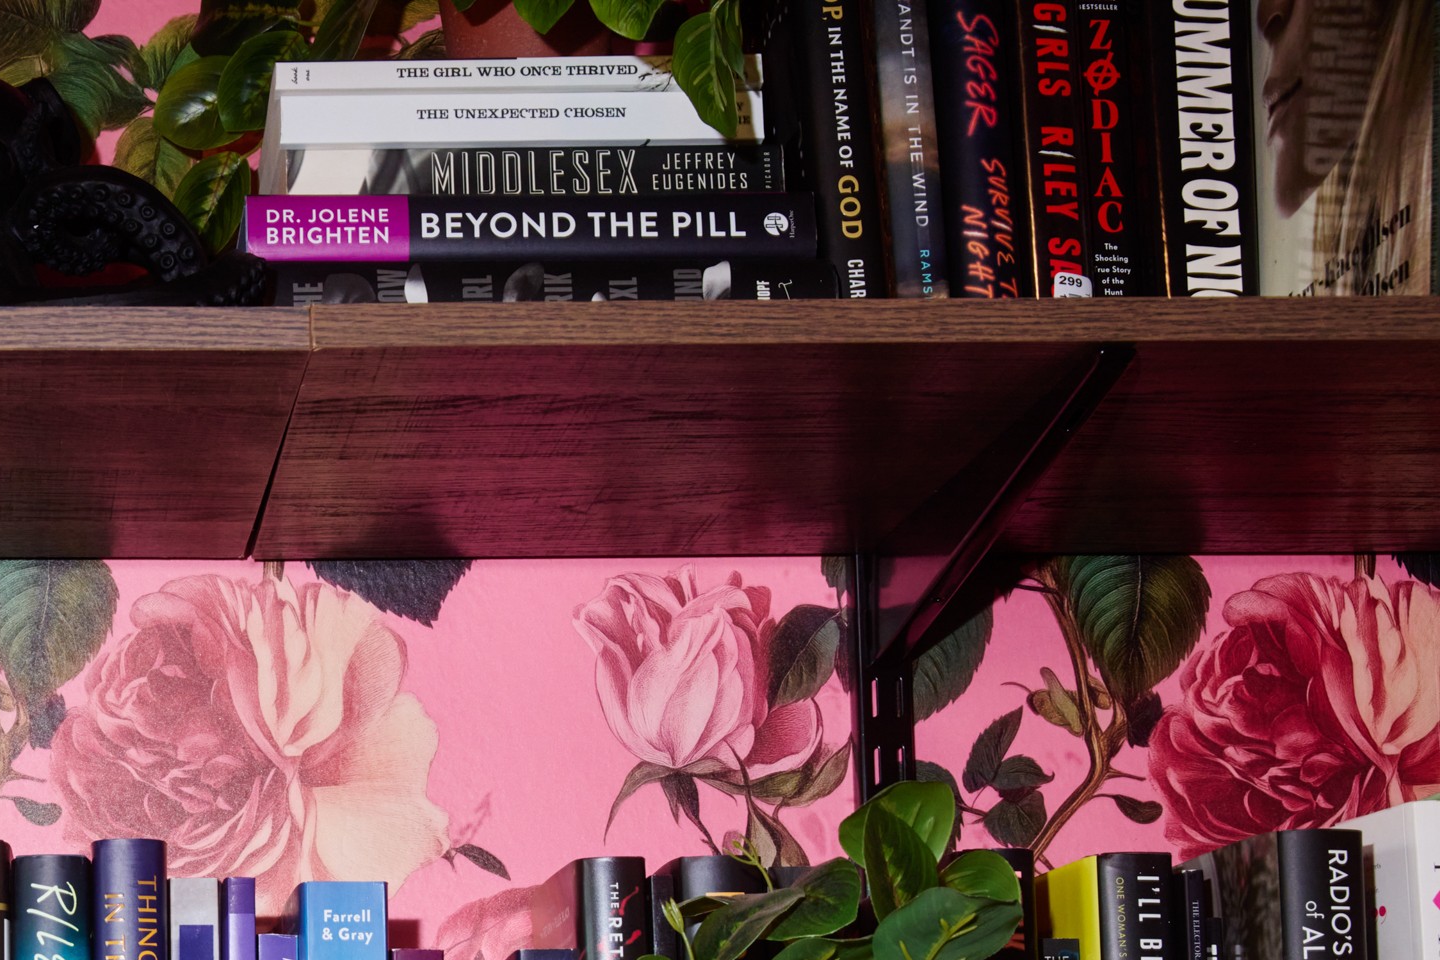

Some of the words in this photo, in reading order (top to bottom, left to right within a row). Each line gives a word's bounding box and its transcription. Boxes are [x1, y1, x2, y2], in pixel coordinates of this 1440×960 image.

[397, 67, 428, 79] THE
[434, 66, 472, 78] GIRL
[477, 66, 516, 78] WHO
[520, 65, 562, 77] ONCE
[567, 64, 639, 77] THRIVED
[416, 109, 449, 121] THE
[453, 108, 560, 120] UNEXPECTED
[564, 106, 627, 119] CHOSEN
[661, 152, 736, 171] JEFFREY
[838, 145, 854, 168] OF
[432, 149, 639, 195] MIDDLESEX
[652, 172, 749, 192] EUGENIDES
[838, 175, 862, 238] GOD
[308, 208, 390, 224] JOLENE
[421, 212, 577, 239] BEYOND
[587, 212, 659, 238] THE
[673, 212, 747, 237] PILL
[266, 226, 390, 245] BRIGHTEN
[1104, 243, 1118, 251] The
[1094, 254, 1130, 264] Shocking
[1058, 274, 1084, 288] 299
[1104, 288, 1123, 296] Hunt
[104, 893, 124, 923] IN
[1328, 849, 1353, 956] RADIO'S
[323, 909, 371, 923] Farrell
[322, 928, 335, 941] &
[338, 927, 373, 945] Gray
